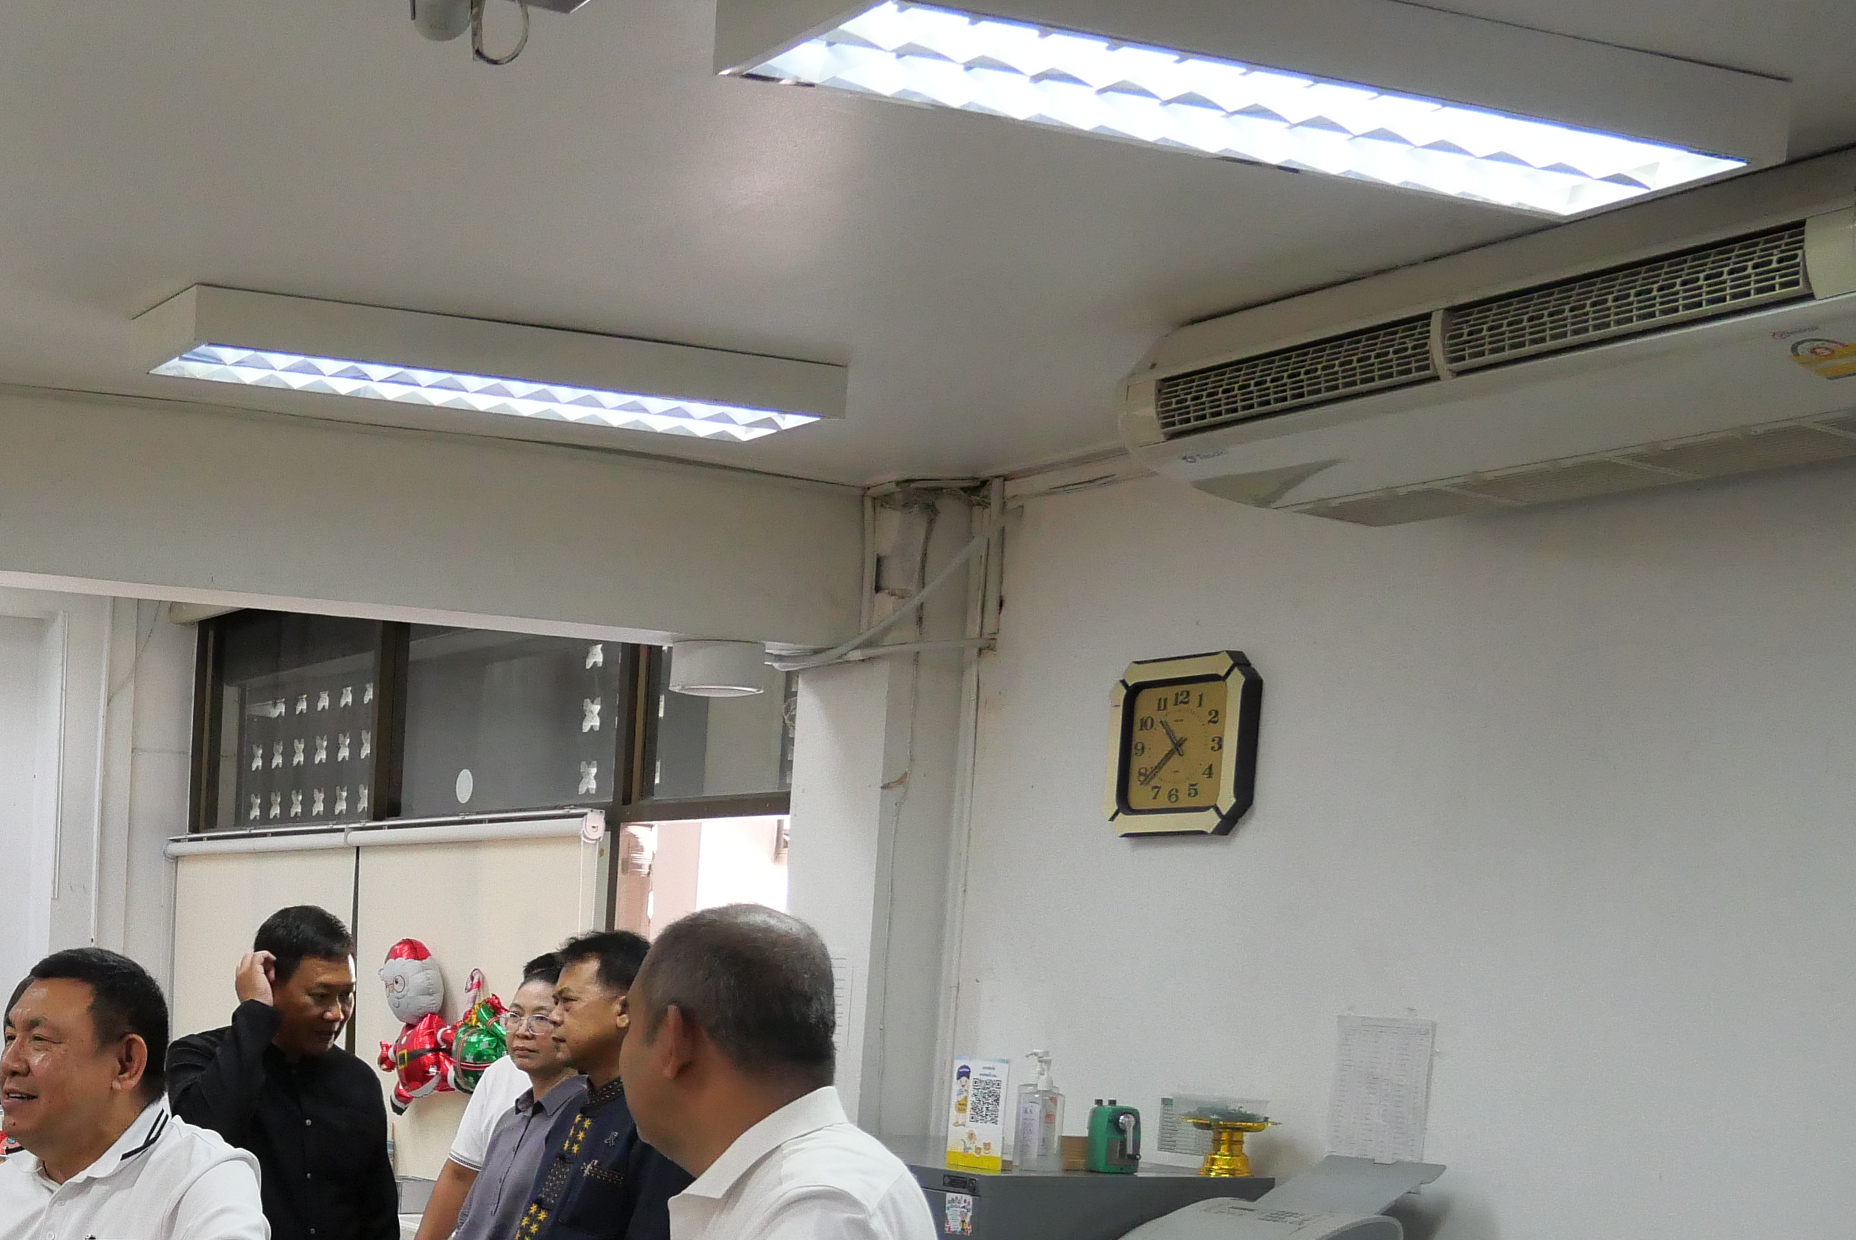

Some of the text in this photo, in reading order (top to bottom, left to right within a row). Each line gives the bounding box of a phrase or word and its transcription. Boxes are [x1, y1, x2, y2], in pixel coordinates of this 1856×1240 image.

[1156, 697, 1168, 711] 11
[1172, 690, 1190, 707] 12
[1196, 693, 1204, 708] 1
[1137, 716, 1155, 731] 10
[1208, 709, 1220, 724] 2
[1134, 742, 1145, 757] 9
[1211, 736, 1224, 752] 3
[1202, 763, 1214, 779] 4
[1151, 785, 1162, 800] 7
[1167, 788, 1179, 803] 6
[1187, 783, 1199, 798] 5
